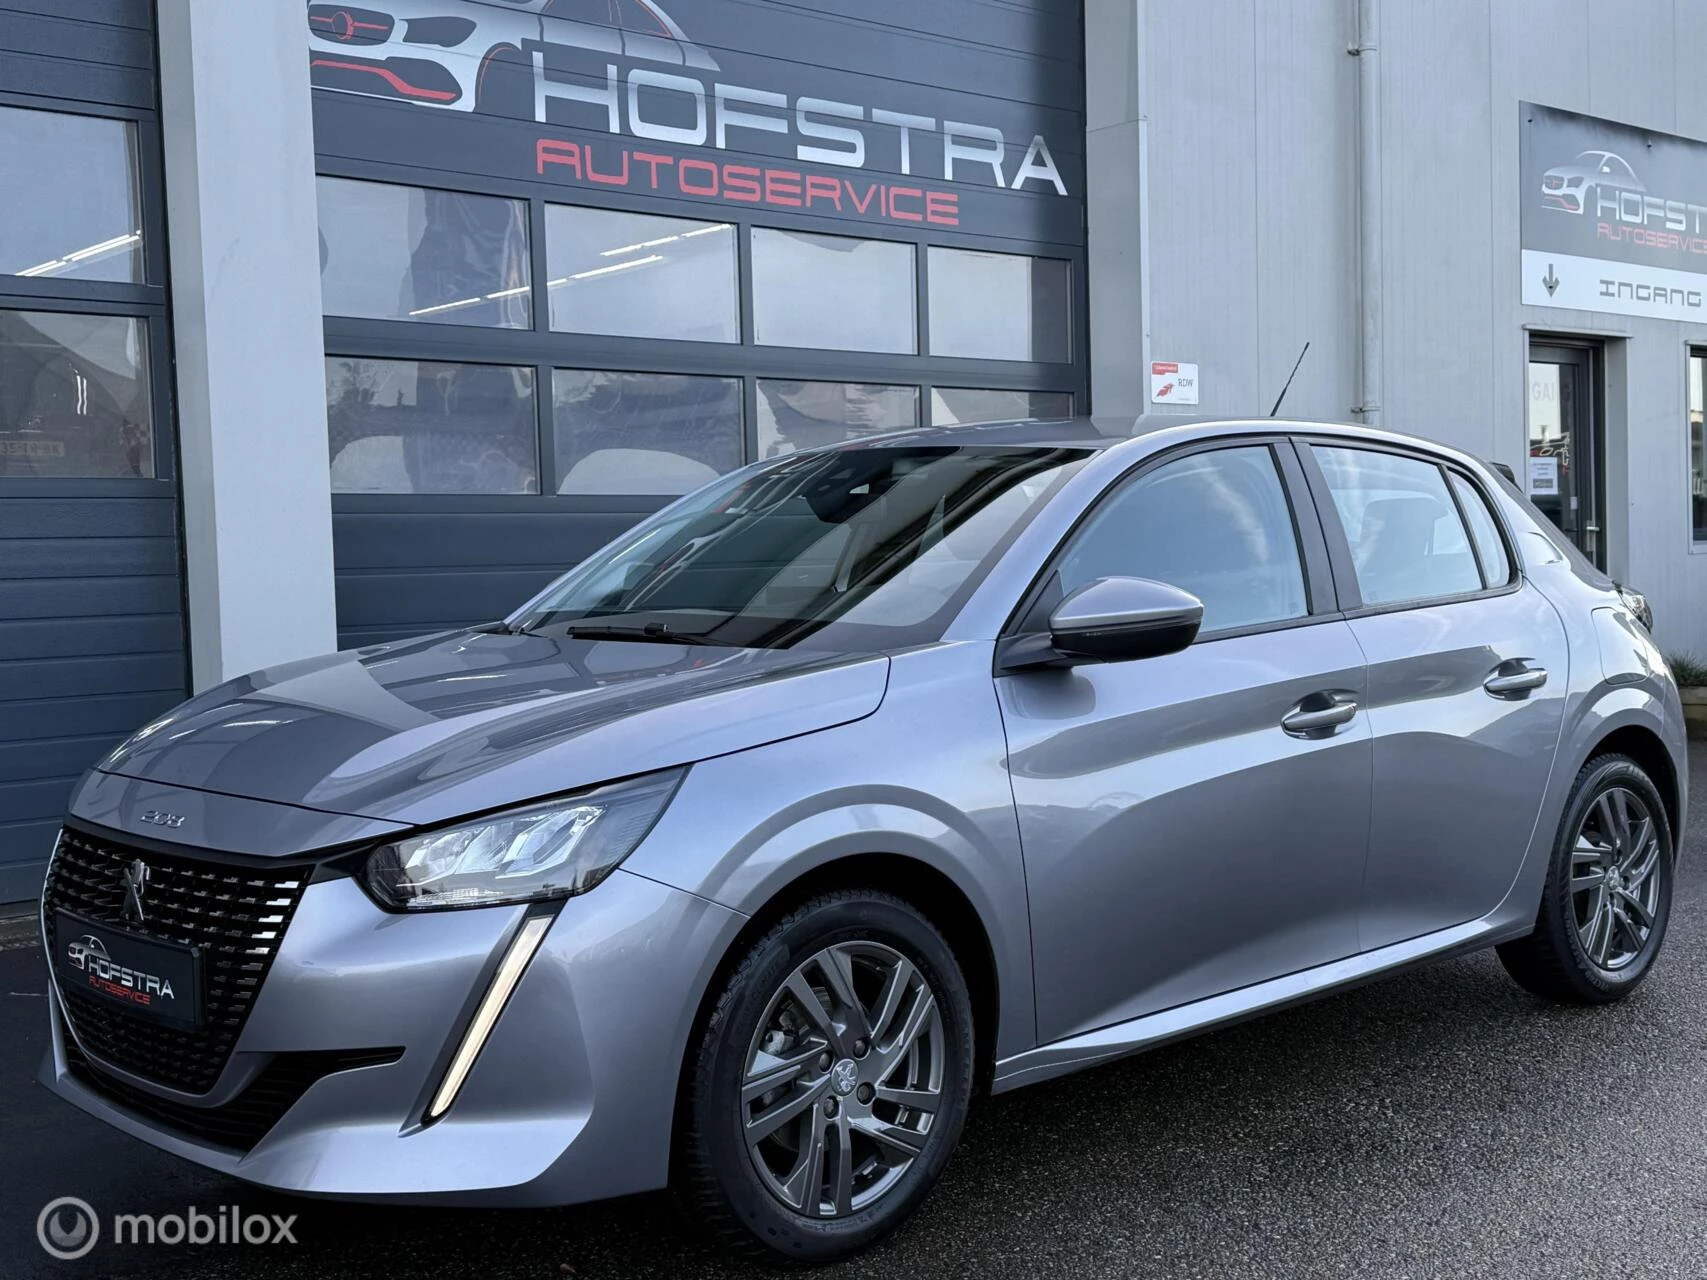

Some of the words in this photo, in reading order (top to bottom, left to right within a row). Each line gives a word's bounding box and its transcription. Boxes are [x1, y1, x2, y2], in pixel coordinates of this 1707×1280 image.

[533, 51, 1068, 196] HOFSTRA
[536, 138, 960, 226] AUTOSERVICE
[1600, 279, 1702, 308] INGANG
[140, 810, 185, 829] 208
[88, 955, 175, 1000] HOFSTRA
[88, 975, 152, 1005] AUTOSERVICE
